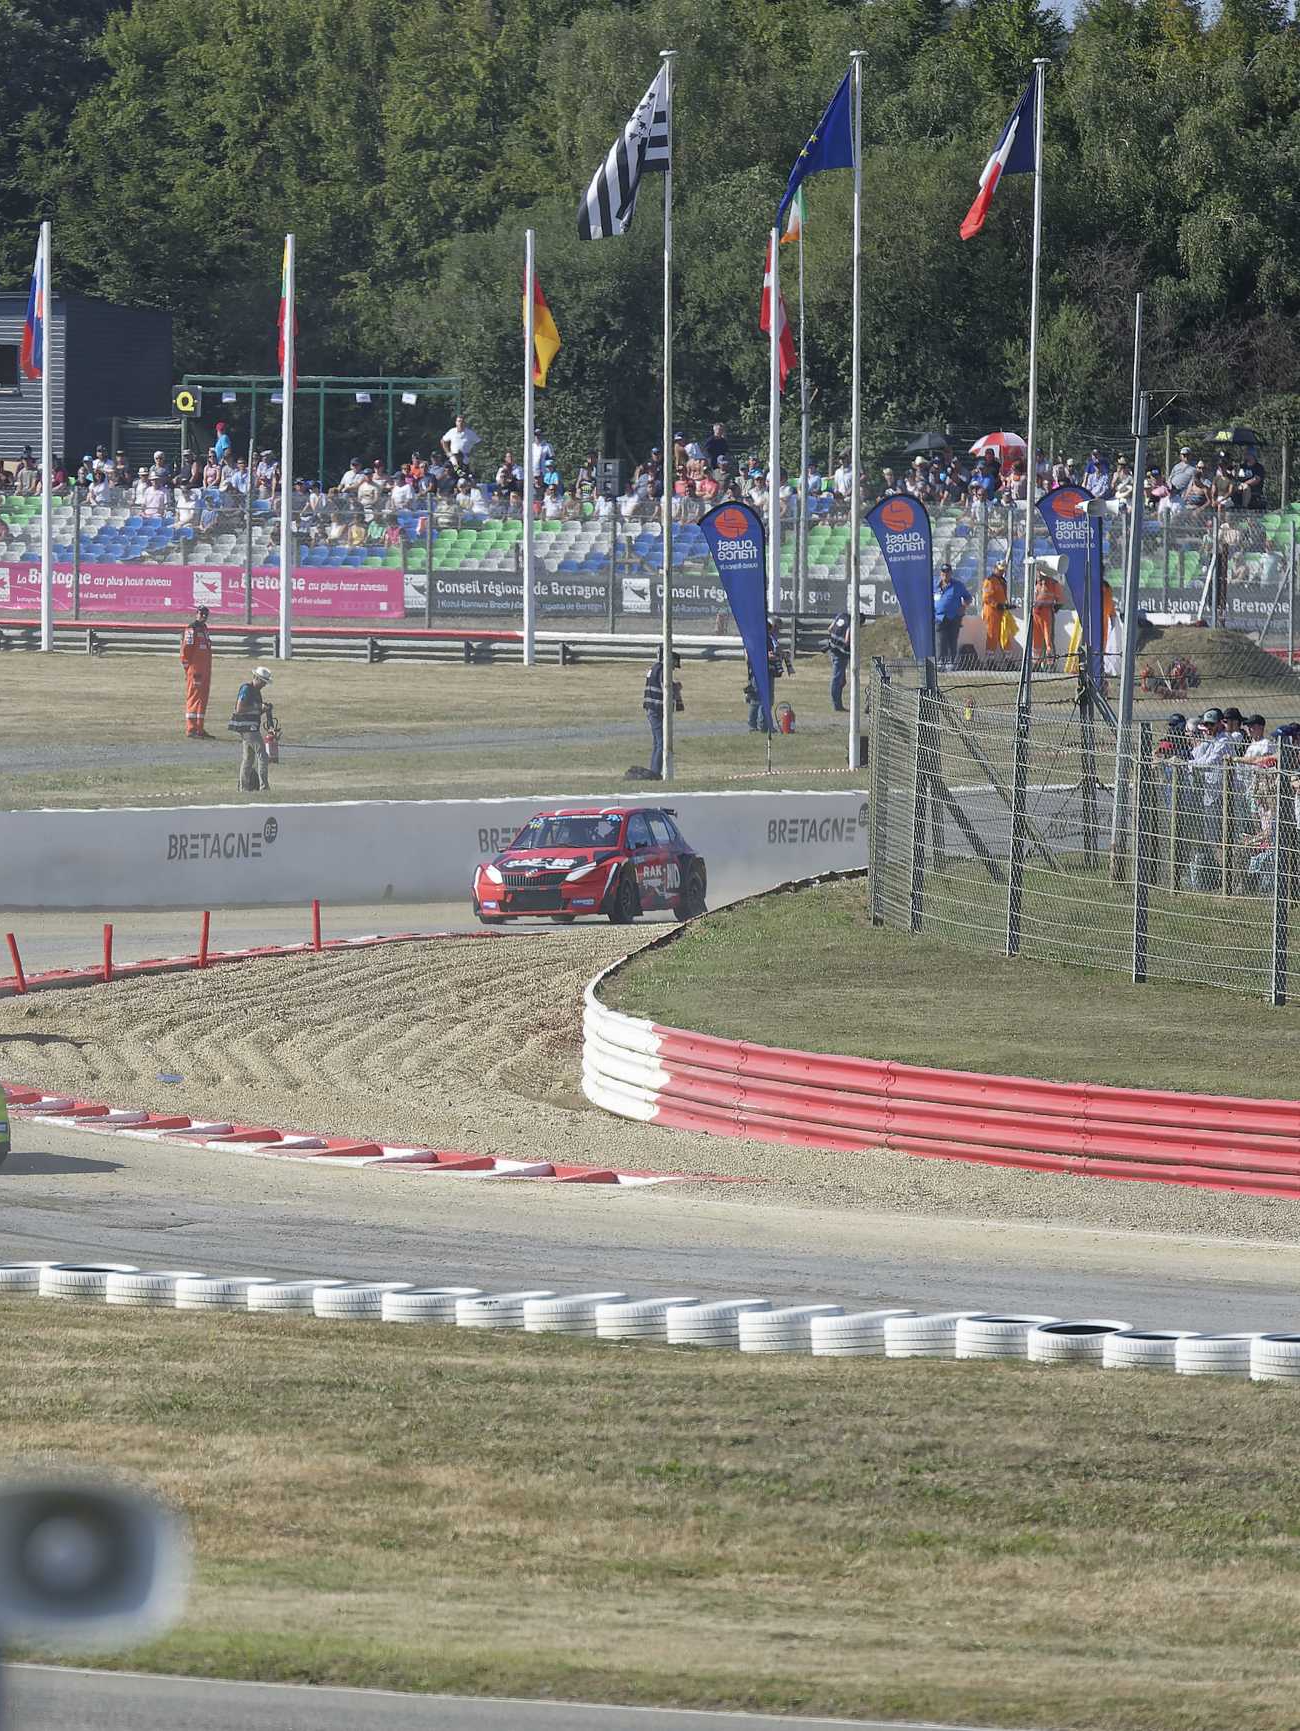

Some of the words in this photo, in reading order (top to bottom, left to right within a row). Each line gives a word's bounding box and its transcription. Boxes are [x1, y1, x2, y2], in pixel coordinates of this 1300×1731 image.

[176, 391, 195, 411] Q
[17, 574, 27, 584] La
[28, 568, 92, 588] Brtage
[94, 577, 105, 585] au
[106, 576, 124, 588] plus
[125, 576, 145, 586] haut
[145, 577, 172, 587] niveau
[228, 579, 239, 588] La
[436, 579, 481, 594] Conseil
[482, 581, 524, 597] régiona
[533, 581, 549, 595] de
[551, 582, 606, 599] Bretagne
[656, 584, 700, 599] Cnseil
[767, 817, 857, 844] BRETAGNE
[167, 832, 262, 860] BRETAGNE
